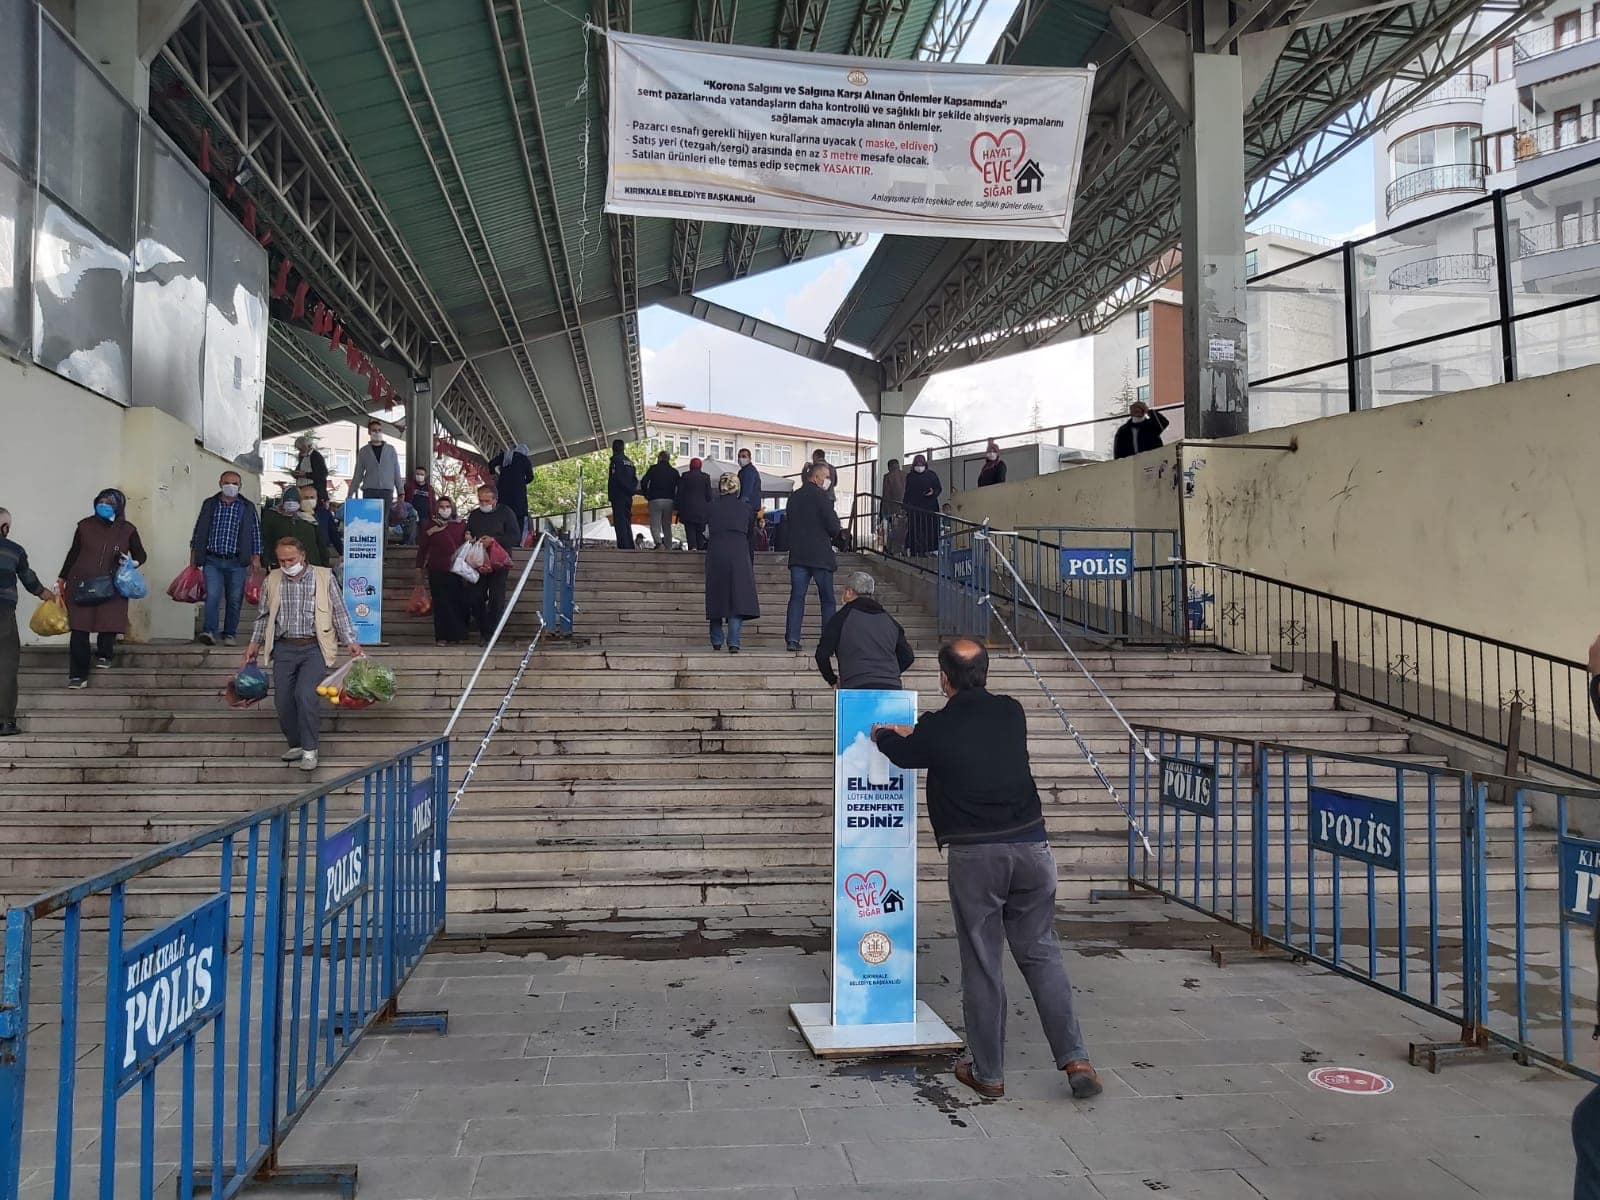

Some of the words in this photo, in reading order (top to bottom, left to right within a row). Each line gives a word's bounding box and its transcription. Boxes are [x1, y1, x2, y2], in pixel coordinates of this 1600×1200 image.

[747, 83, 782, 95] Salgını
[784, 86, 796, 95] ve
[798, 86, 835, 98] Salgına
[837, 90, 863, 100] Karşı
[864, 90, 896, 101] Alınan
[897, 91, 942, 104] Önlemler
[637, 87, 662, 99] semt
[664, 91, 727, 105] pazarlarında
[729, 96, 797, 109] vatandaşların
[799, 100, 824, 111] daha
[825, 102, 870, 114] kontrollü
[872, 106, 884, 115] ve
[886, 106, 921, 118] sağlıklı
[922, 108, 936, 118] bir
[938, 109, 971, 121] şekilde
[973, 112, 1011, 125] alışveriş
[1013, 116, 1064, 128] yapmalarını
[771, 112, 818, 125] sağlamak
[820, 115, 865, 129] amacıyla
[866, 119, 897, 129] alınan
[898, 121, 943, 133] önlemler.
[632, 121, 668, 132] Pazarcı
[670, 124, 699, 137] esnafı
[702, 128, 735, 139] gerekli
[737, 130, 768, 142] hijyen
[769, 132, 821, 144] kurallarına
[822, 137, 856, 147] uyacak
[865, 139, 898, 150] maske,
[900, 141, 938, 152] eldiven)
[632, 135, 657, 146] Satış
[658, 137, 677, 147] yeri
[679, 139, 749, 155] (tezgah/sergi)
[751, 145, 793, 156] arasında
[795, 150, 807, 158] en
[822, 150, 828, 159] 3
[830, 151, 859, 161] metre
[860, 153, 894, 163] mesafe
[896, 155, 929, 166] olacak.
[982, 147, 1012, 160] HAYAT
[632, 149, 666, 160] Satılan
[668, 152, 706, 163] ürünleri
[708, 155, 726, 166] elle
[728, 158, 758, 168] temas
[760, 160, 782, 171] edip
[783, 162, 821, 173] seçmek
[822, 163, 873, 175] YASAKTIR.
[983, 160, 1012, 184] EVE
[624, 186, 667, 197] KIRIKKALE
[668, 188, 706, 200] BELEDİYE
[707, 192, 756, 204] BAŞKANLIĞI
[983, 184, 1013, 198] SIĞAR
[911, 195, 924, 205] için
[1000, 201, 1023, 211] günler
[954, 556, 972, 578] POLİS
[1069, 553, 1127, 576] POLİS
[847, 792, 874, 800] LÜTFEN
[1163, 768, 1210, 806] POLİS
[412, 793, 431, 839] POLİS
[847, 803, 904, 812] DEZENFEKTE
[847, 813, 904, 828] EDİNİZ
[1320, 809, 1392, 858] POLİS
[324, 837, 362, 912] POLİS
[855, 882, 876, 892] HAYAT
[856, 890, 879, 908] EVE
[858, 908, 881, 918] SIĞAR
[126, 934, 186, 992] KIRIKKALE
[123, 943, 213, 1068] POLİS
